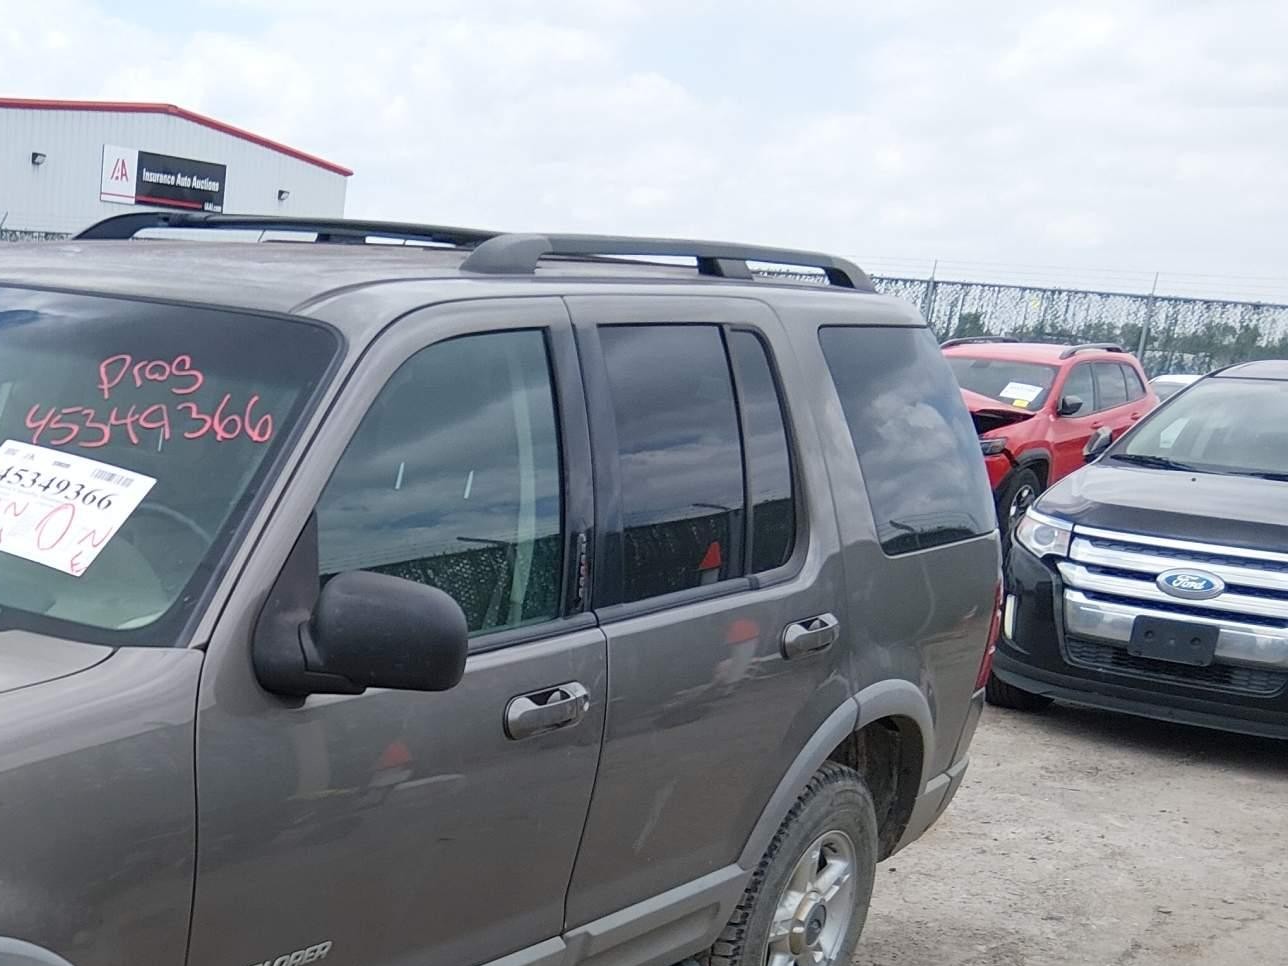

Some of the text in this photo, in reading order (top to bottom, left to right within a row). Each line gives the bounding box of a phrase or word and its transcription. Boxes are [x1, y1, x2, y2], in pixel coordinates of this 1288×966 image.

[142, 167, 220, 193] Insurance Auto Auctions
[25, 393, 273, 449] 45349366
[1172, 574, 1207, 590] Ford
